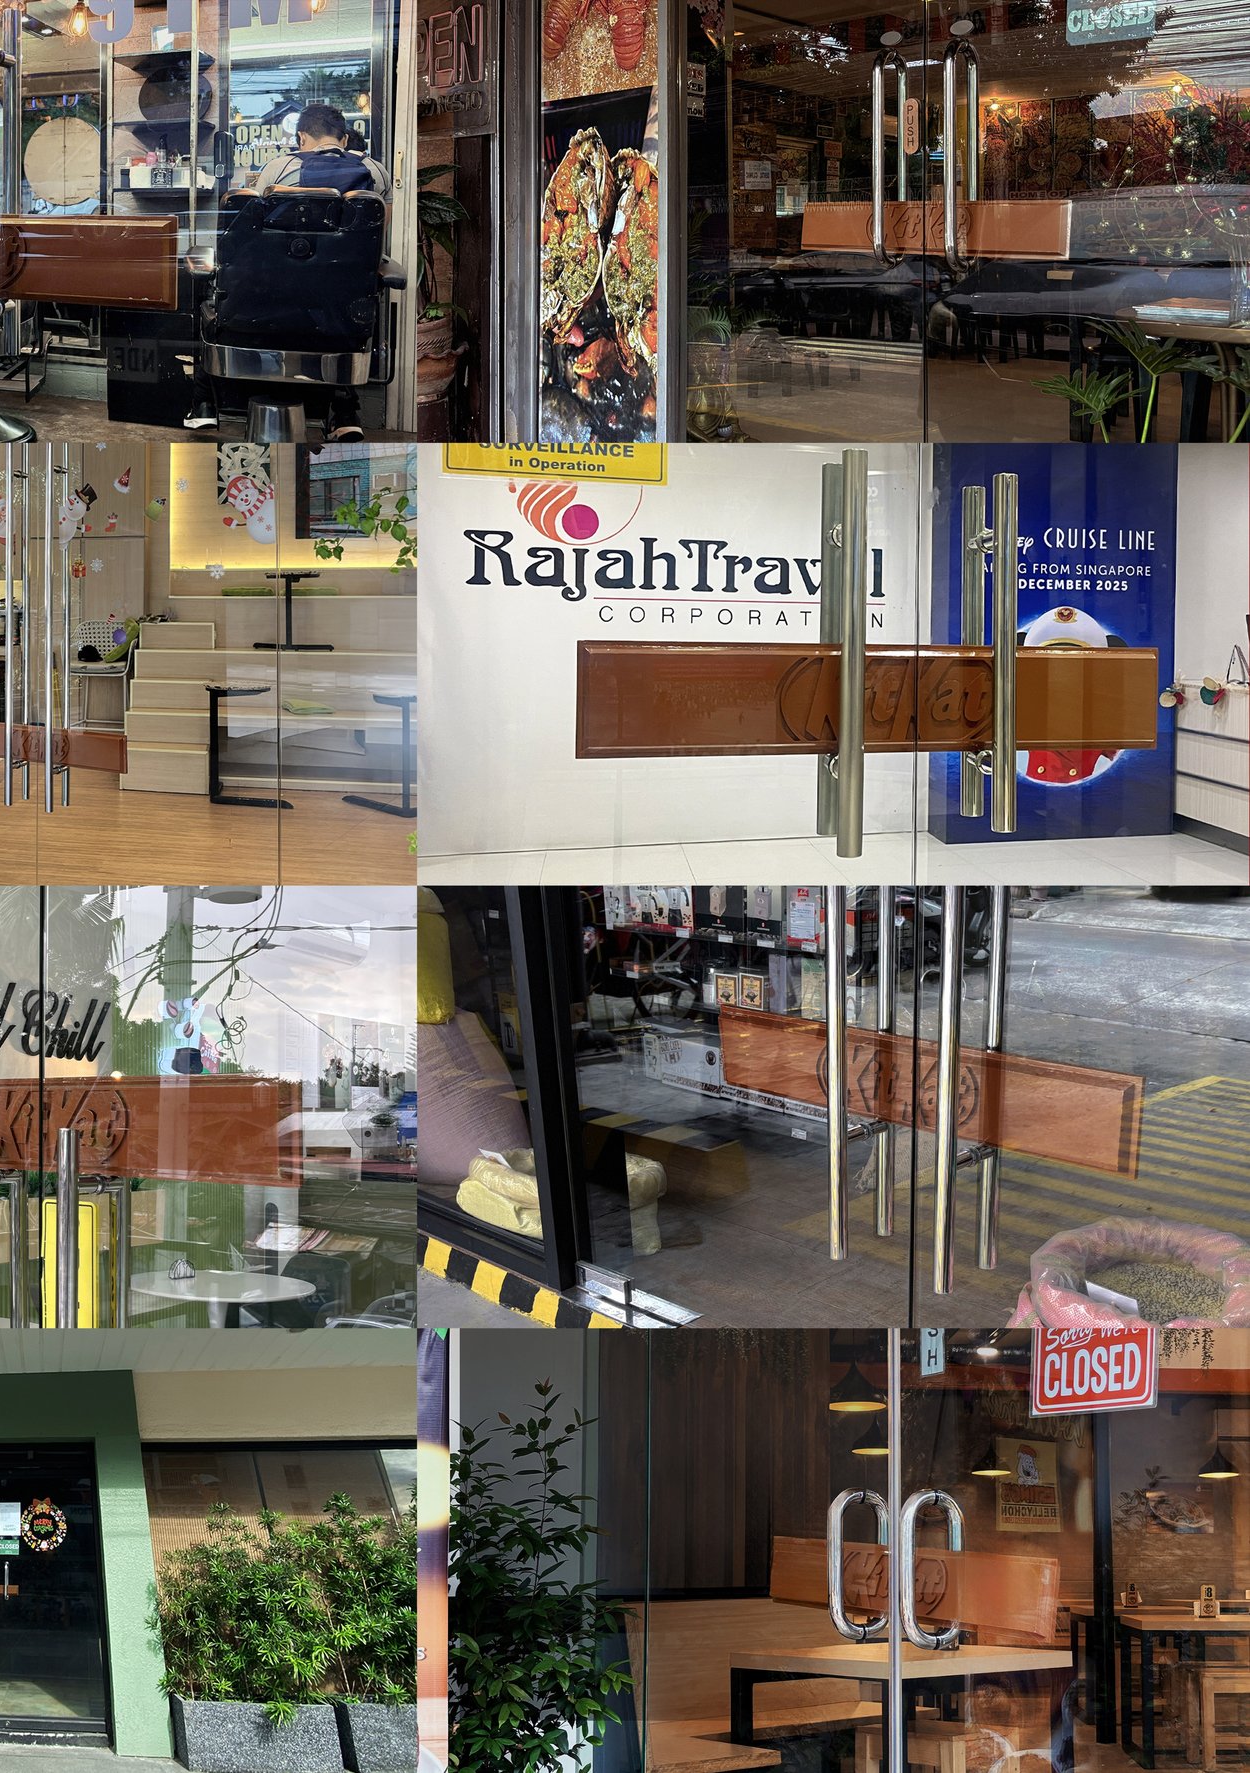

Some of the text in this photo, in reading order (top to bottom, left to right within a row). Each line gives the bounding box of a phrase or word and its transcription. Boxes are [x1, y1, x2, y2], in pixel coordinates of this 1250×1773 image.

[1067, 1, 1155, 34] CLOSED
[236, 124, 283, 146] OPEN
[906, 104, 915, 147] PUSH
[509, 457, 606, 472] in Operation
[1043, 527, 1108, 549] CRUISE
[1119, 529, 1155, 551] LINE
[1033, 563, 1070, 575] FROM
[1076, 564, 1151, 577] SINGAPORE
[1018, 578, 1128, 591] DECEMBER 2025
[599, 605, 883, 628] CORPORATN
[22, 988, 111, 1062] Chill
[1044, 1343, 1141, 1398] CLOSED
